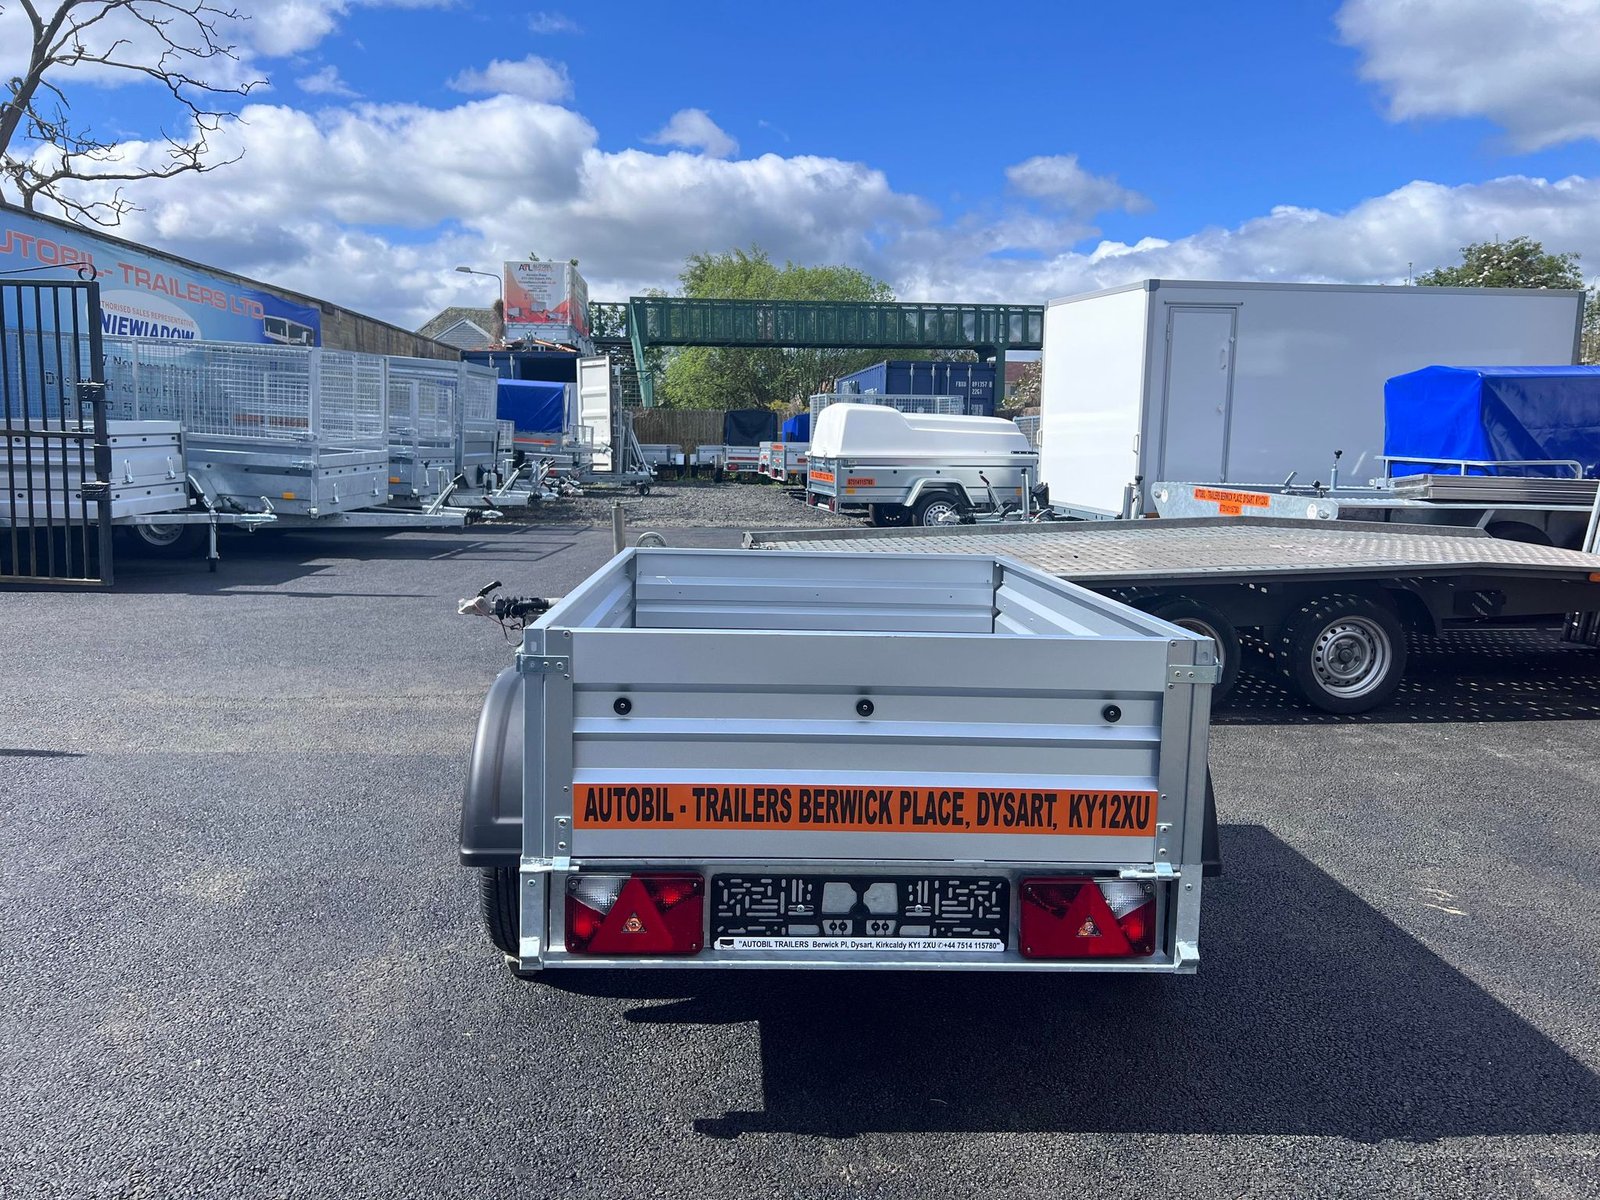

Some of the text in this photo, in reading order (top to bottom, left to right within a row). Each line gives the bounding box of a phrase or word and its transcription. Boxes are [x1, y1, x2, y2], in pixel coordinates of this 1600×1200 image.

[117, 262, 227, 311] TRAILERS
[230, 294, 264, 319] LTD
[101, 300, 131, 313] THORISED
[131, 307, 150, 318] SALES
[583, 787, 674, 822] AUTOBIL
[692, 787, 792, 823] TRAILERS
[799, 788, 893, 825] BERWICK
[900, 789, 970, 829] PLACE,
[977, 791, 1057, 831] DYSART,
[1068, 794, 1151, 830] KY12XU
[774, 940, 809, 949] TRAILERS
[812, 941, 840, 949] Berwick
[850, 941, 874, 950] Dysart,
[875, 941, 907, 951] Kirkcaldy
[908, 941, 921, 949] KY1
[922, 941, 936, 949] 2XU
[957, 942, 973, 950] 7514
